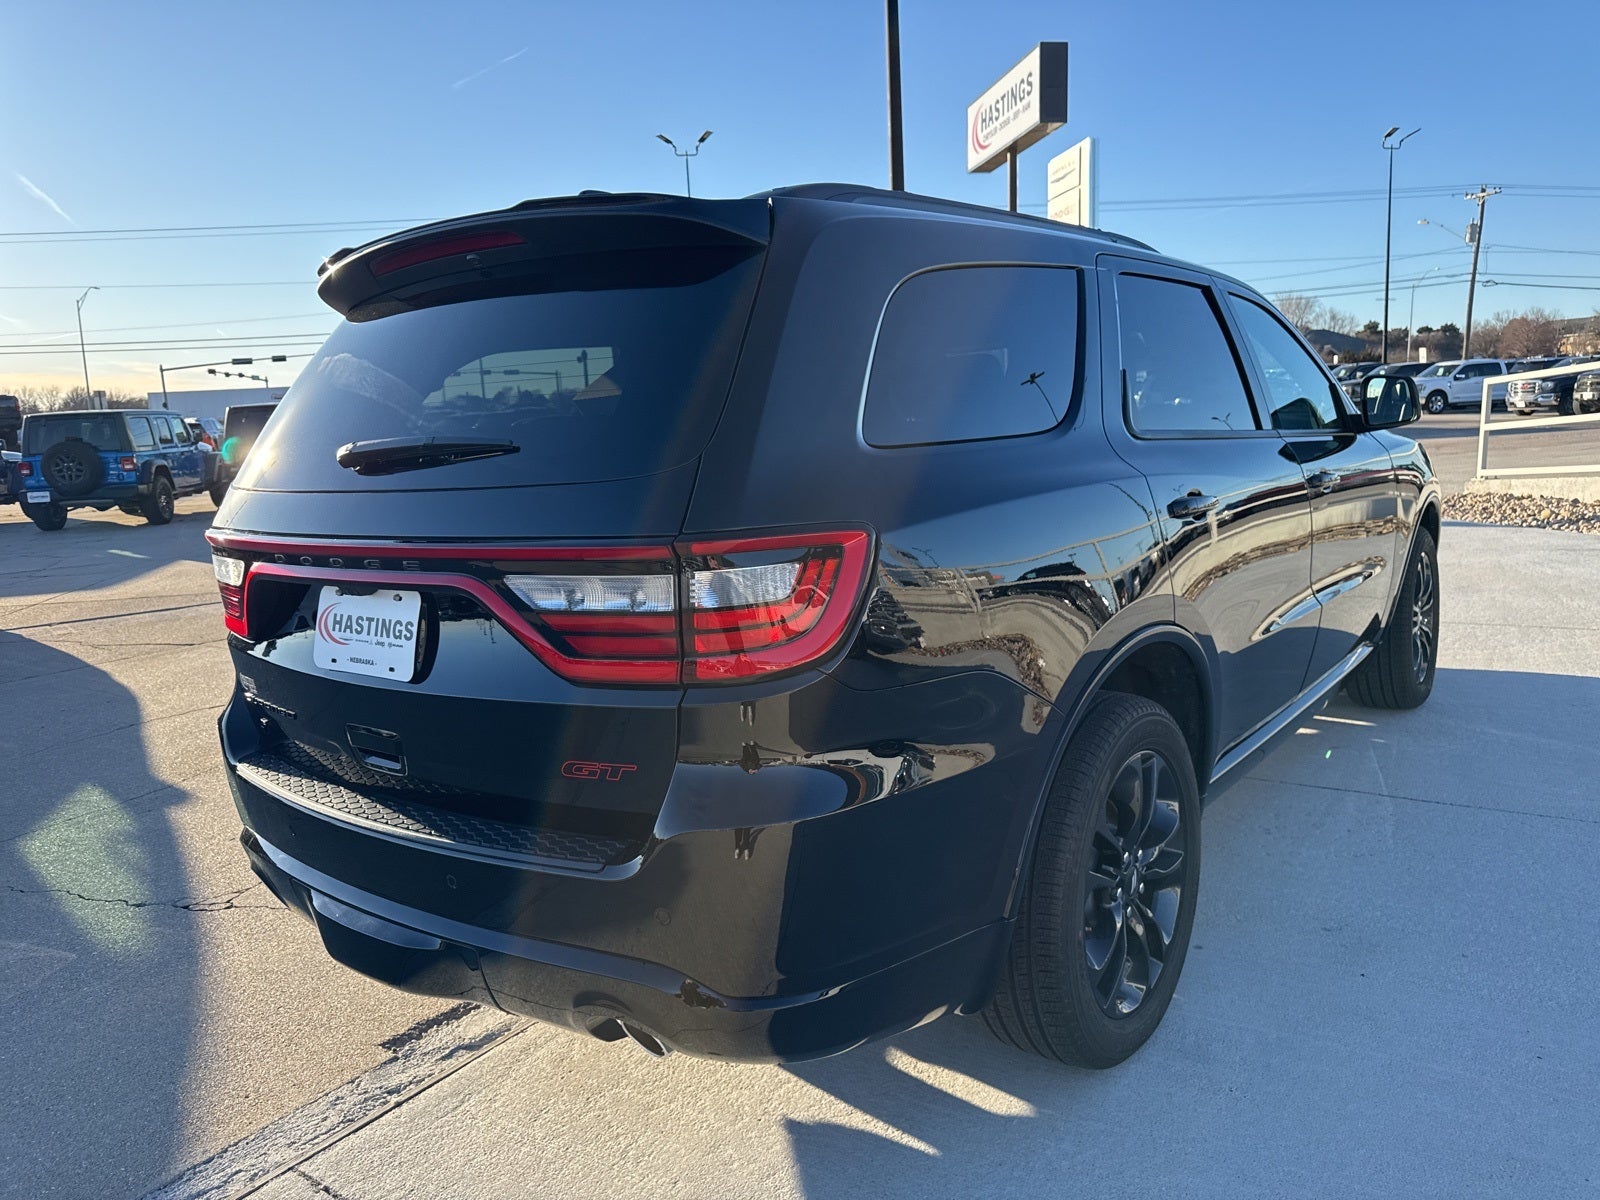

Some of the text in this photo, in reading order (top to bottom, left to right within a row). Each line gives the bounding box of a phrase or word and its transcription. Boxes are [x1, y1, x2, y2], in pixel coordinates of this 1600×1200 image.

[980, 71, 1033, 133] HASTINGS
[274, 553, 421, 571] DODGE
[331, 612, 415, 642] HASTINGS
[349, 656, 375, 667] NEBRASKA
[561, 760, 638, 781] GT
